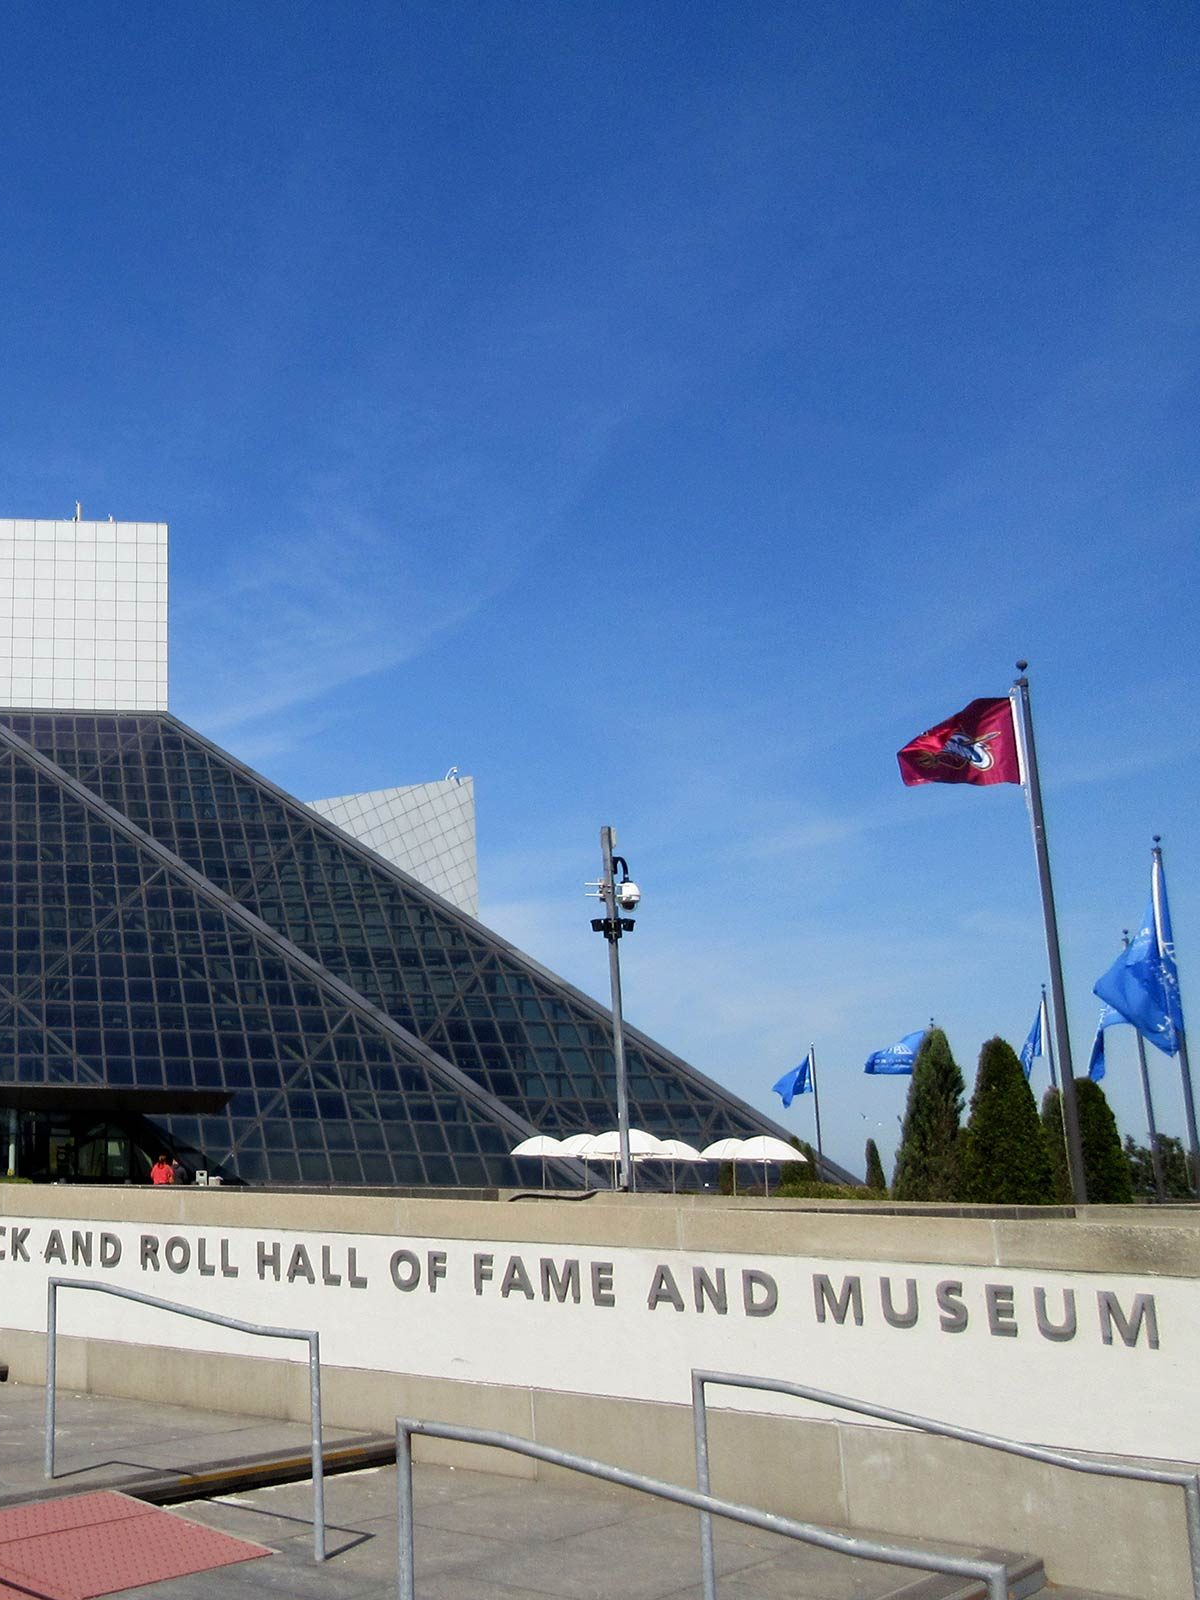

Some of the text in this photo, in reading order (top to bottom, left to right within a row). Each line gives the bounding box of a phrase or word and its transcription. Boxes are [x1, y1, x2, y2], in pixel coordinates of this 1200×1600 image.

[43, 1229, 122, 1269] AND
[140, 1234, 239, 1278] ROLL
[256, 1241, 368, 1289] HALL
[389, 1249, 448, 1294] OF
[473, 1253, 616, 1308] FAME
[647, 1264, 779, 1318] AND
[812, 1273, 1160, 1350] MUSEUM
